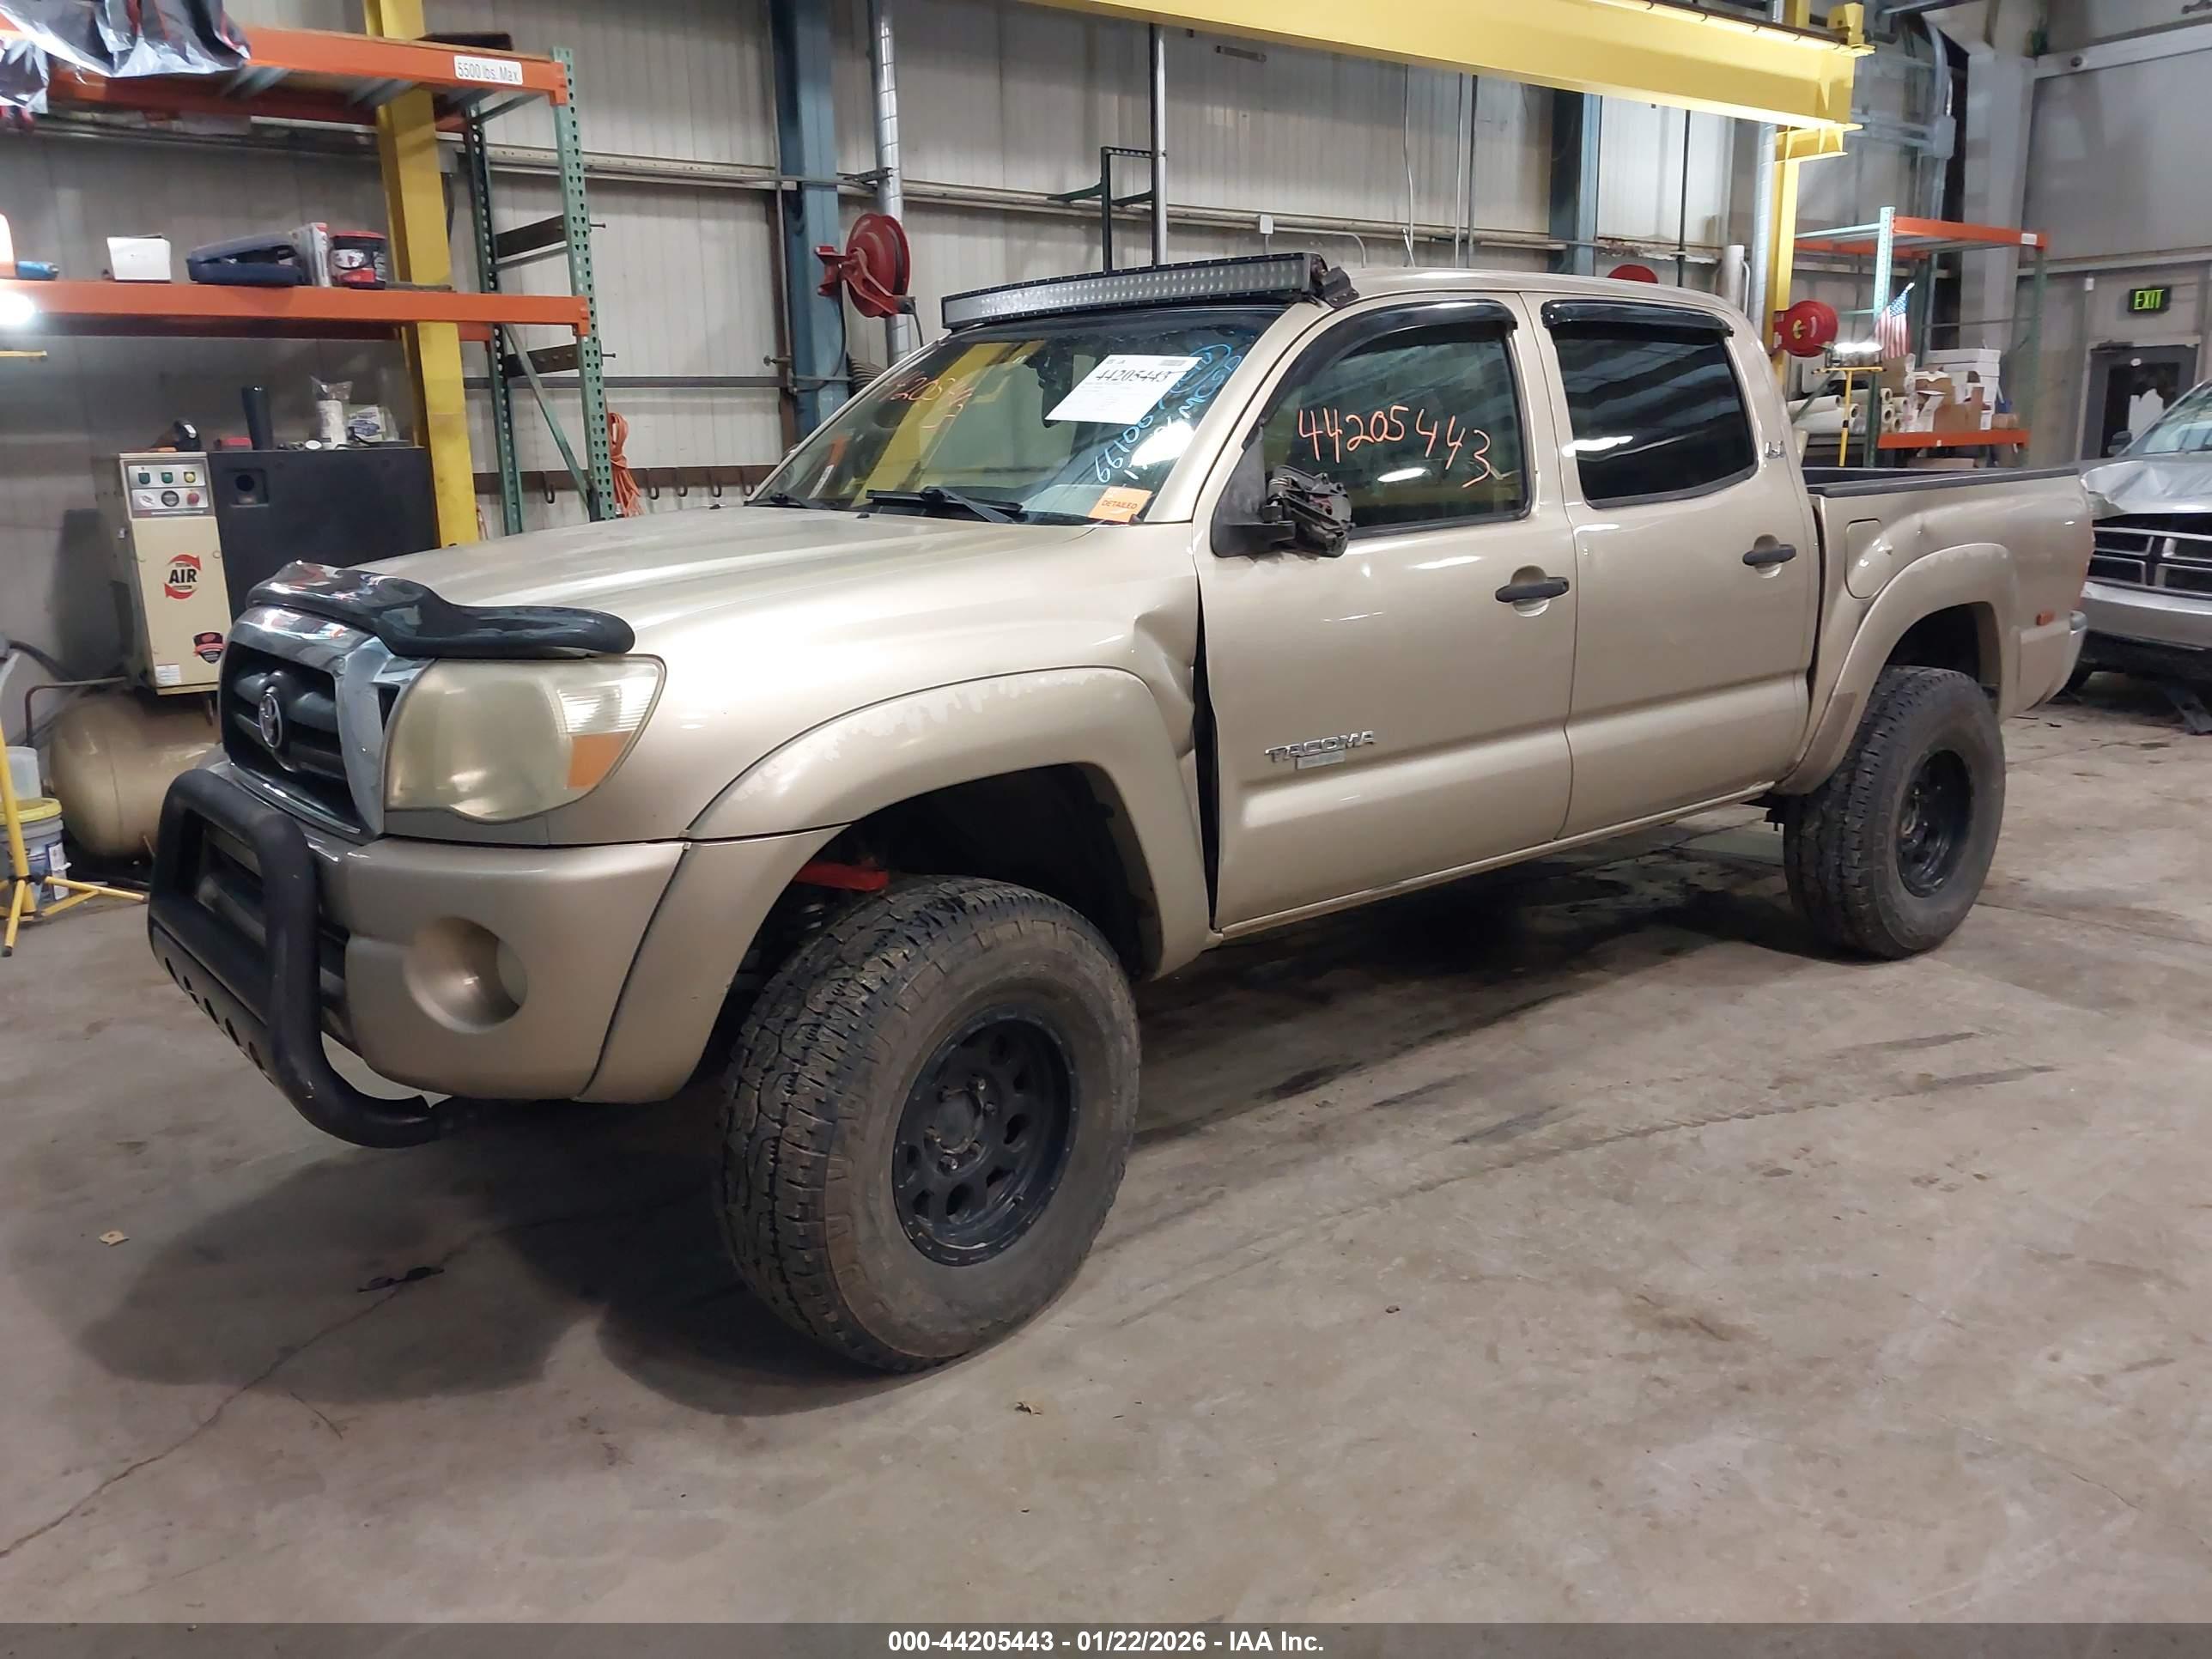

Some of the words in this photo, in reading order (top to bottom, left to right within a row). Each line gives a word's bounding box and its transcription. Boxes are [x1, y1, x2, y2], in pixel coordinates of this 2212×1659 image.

[458, 62, 481, 79] 5500
[499, 66, 519, 82] Max
[2134, 289, 2164, 310] EXIT
[1096, 369, 1169, 383] 44205443
[1297, 404, 1492, 489] 44205443
[1101, 500, 1138, 509] DETAILED
[168, 568, 198, 584] AIR
[1264, 730, 1376, 763] TACOMA
